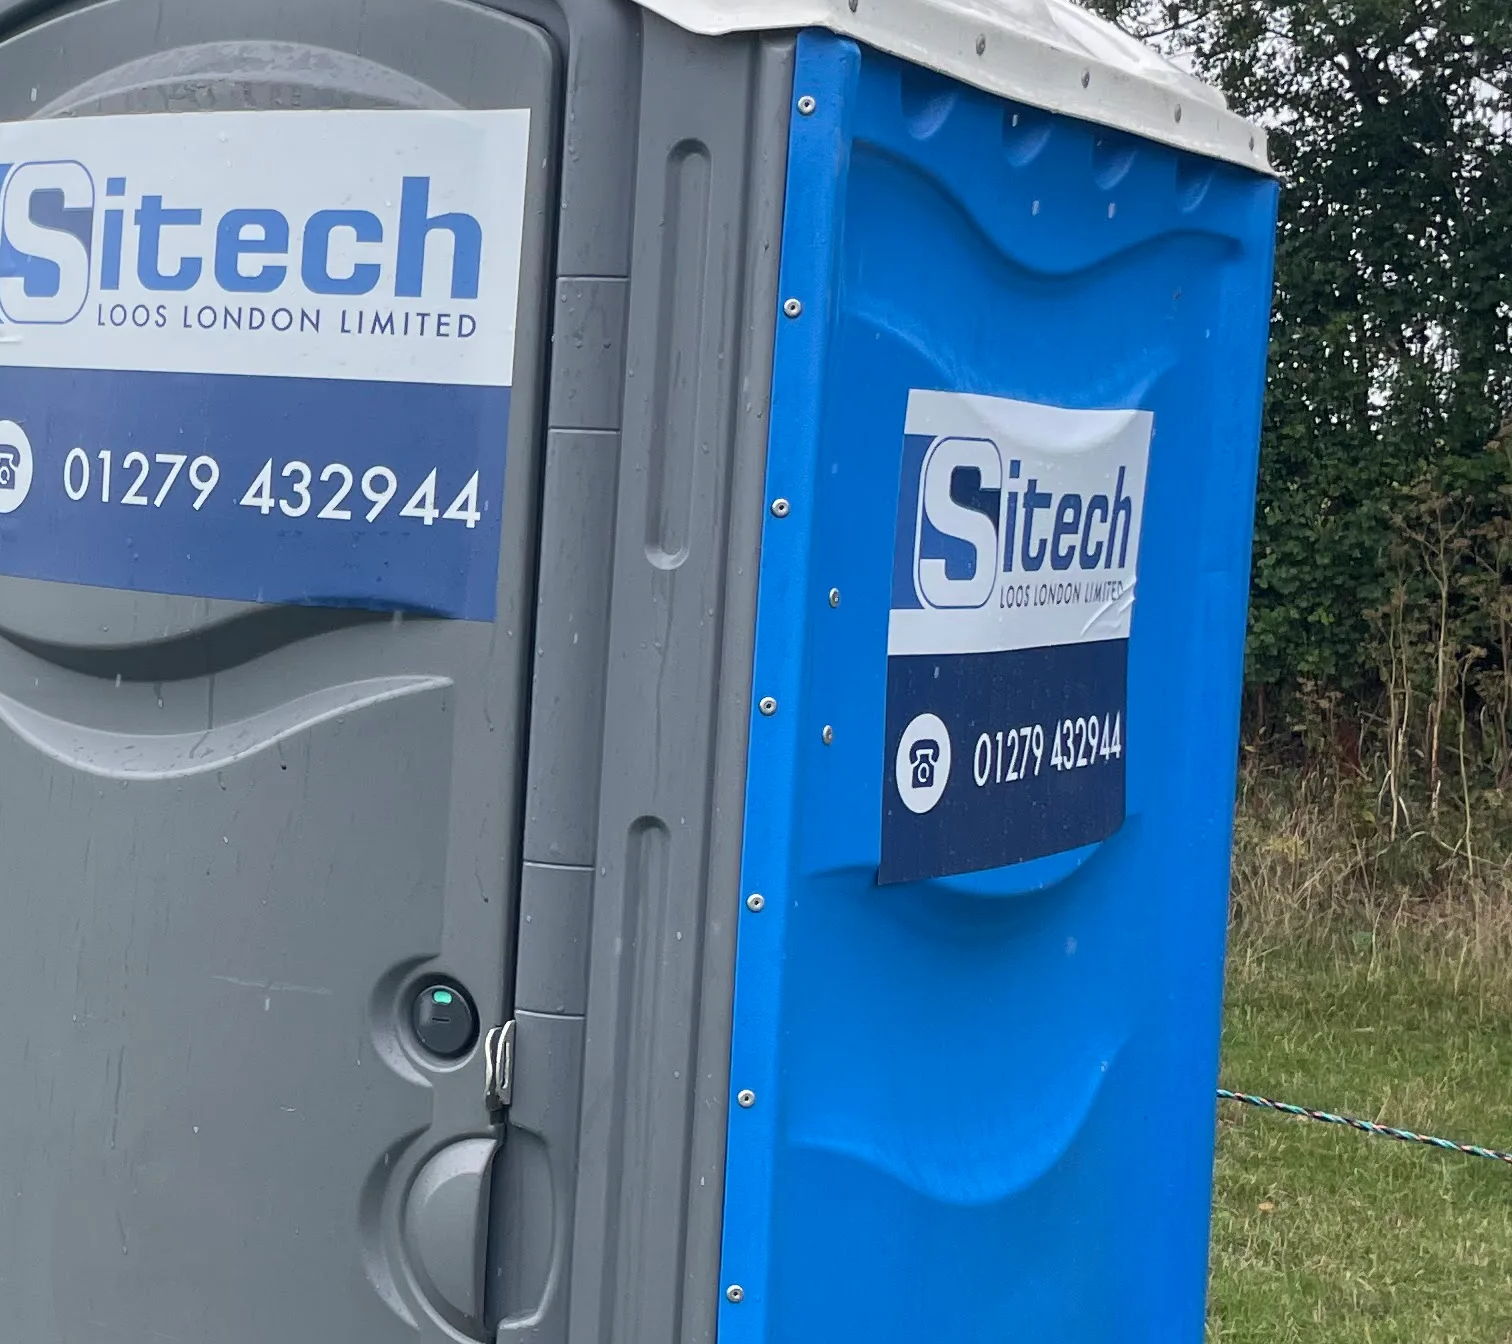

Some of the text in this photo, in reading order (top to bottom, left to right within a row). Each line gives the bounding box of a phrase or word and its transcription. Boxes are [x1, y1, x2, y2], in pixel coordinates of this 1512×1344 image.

[97, 303, 478, 339] LOOS LONDON LIMITED
[63, 446, 483, 530] 01279 432944
[912, 434, 1133, 610] Sitech
[999, 584, 1031, 609] LOOS
[1034, 581, 1082, 607] LONDON
[972, 709, 1123, 788] 01279 432944
